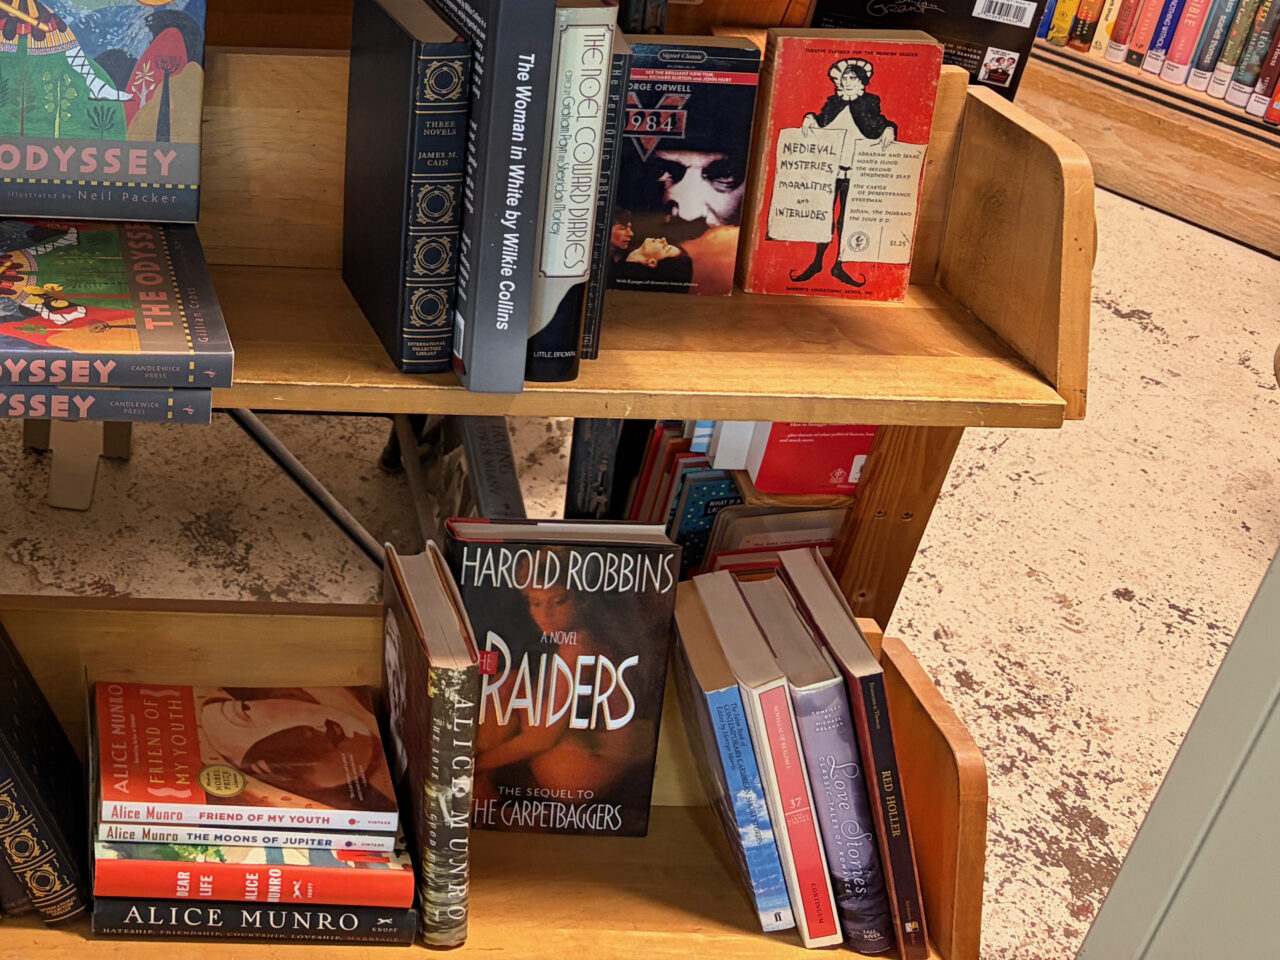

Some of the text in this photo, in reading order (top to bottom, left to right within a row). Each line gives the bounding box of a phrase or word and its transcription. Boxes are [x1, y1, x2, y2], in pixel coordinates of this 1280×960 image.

[654, 84, 691, 92] ORWELL
[783, 142, 836, 156] MEDIEVAL
[78, 189, 112, 202] Neil
[122, 191, 177, 204] Packer
[497, 53, 536, 331] The Woman in White by Wilkie Collins
[775, 208, 828, 221] INTERLUDES
[461, 546, 674, 594] HAROLD ROBBINS
[479, 630, 639, 730] RAIDERS
[111, 806, 330, 824] Alice Munro FRIEND OF MY YOUTH
[495, 800, 622, 832] CARPETBAGGERS
[882, 771, 900, 837] RED HOLLER
[124, 906, 359, 931] ALICE MUNRO
